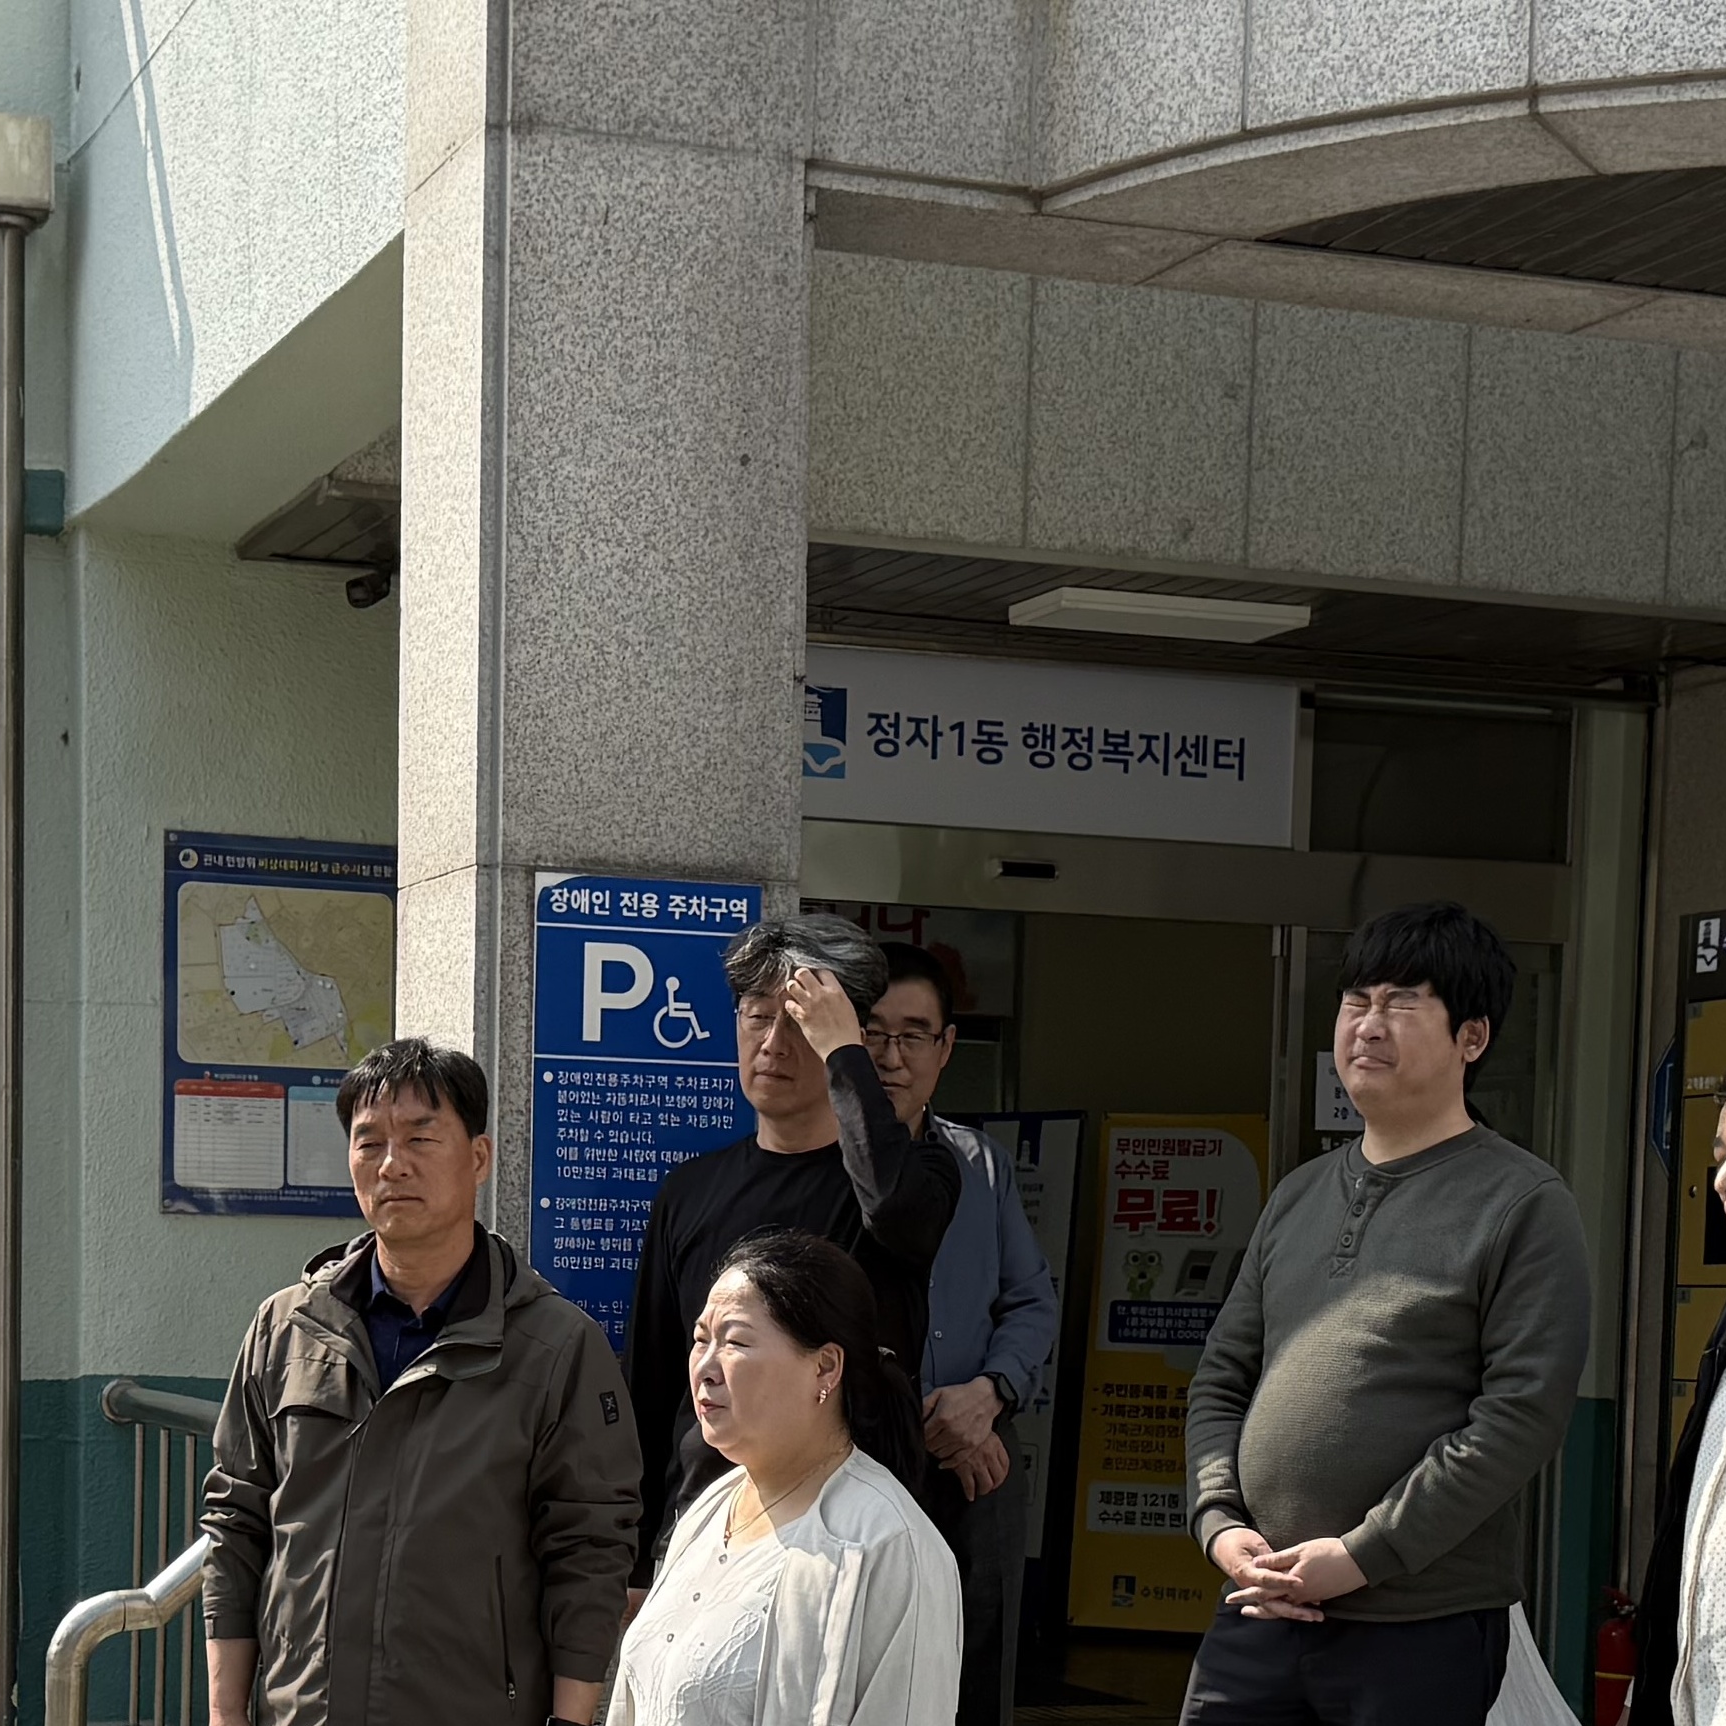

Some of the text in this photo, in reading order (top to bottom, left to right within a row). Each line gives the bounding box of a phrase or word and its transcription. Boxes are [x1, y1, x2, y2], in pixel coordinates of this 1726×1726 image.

[866, 712, 1247, 781] 정자1동 행정복지센터
[549, 887, 748, 925] 장애인 전용 주차구역
[582, 941, 654, 1042] P
[557, 1071, 669, 1088] 장애인전용주차구역
[702, 1096, 734, 1110] 장애가
[557, 1110, 581, 1123] 있는
[588, 1110, 623, 1124] 사람이
[629, 1112, 652, 1125] 타고
[658, 1113, 681, 1127] 있는
[557, 1128, 655, 1144] 주차할 수 있습니다.
[556, 1146, 579, 1161] 이를
[584, 1148, 618, 1162] 위반한
[623, 1149, 657, 1164] 사람에
[1116, 1138, 1223, 1157] 무인민원발급기
[557, 1166, 607, 1180] 10만원의
[612, 1167, 658, 1182] 과태료를
[1114, 1159, 1170, 1181] 수수료
[1113, 1188, 1218, 1234] 무료!
[554, 1217, 565, 1228] 그
[1105, 1439, 1165, 1454] 기본증명서
[1098, 1491, 1138, 1507] 제증명
[1098, 1510, 1136, 1525] 수수료
